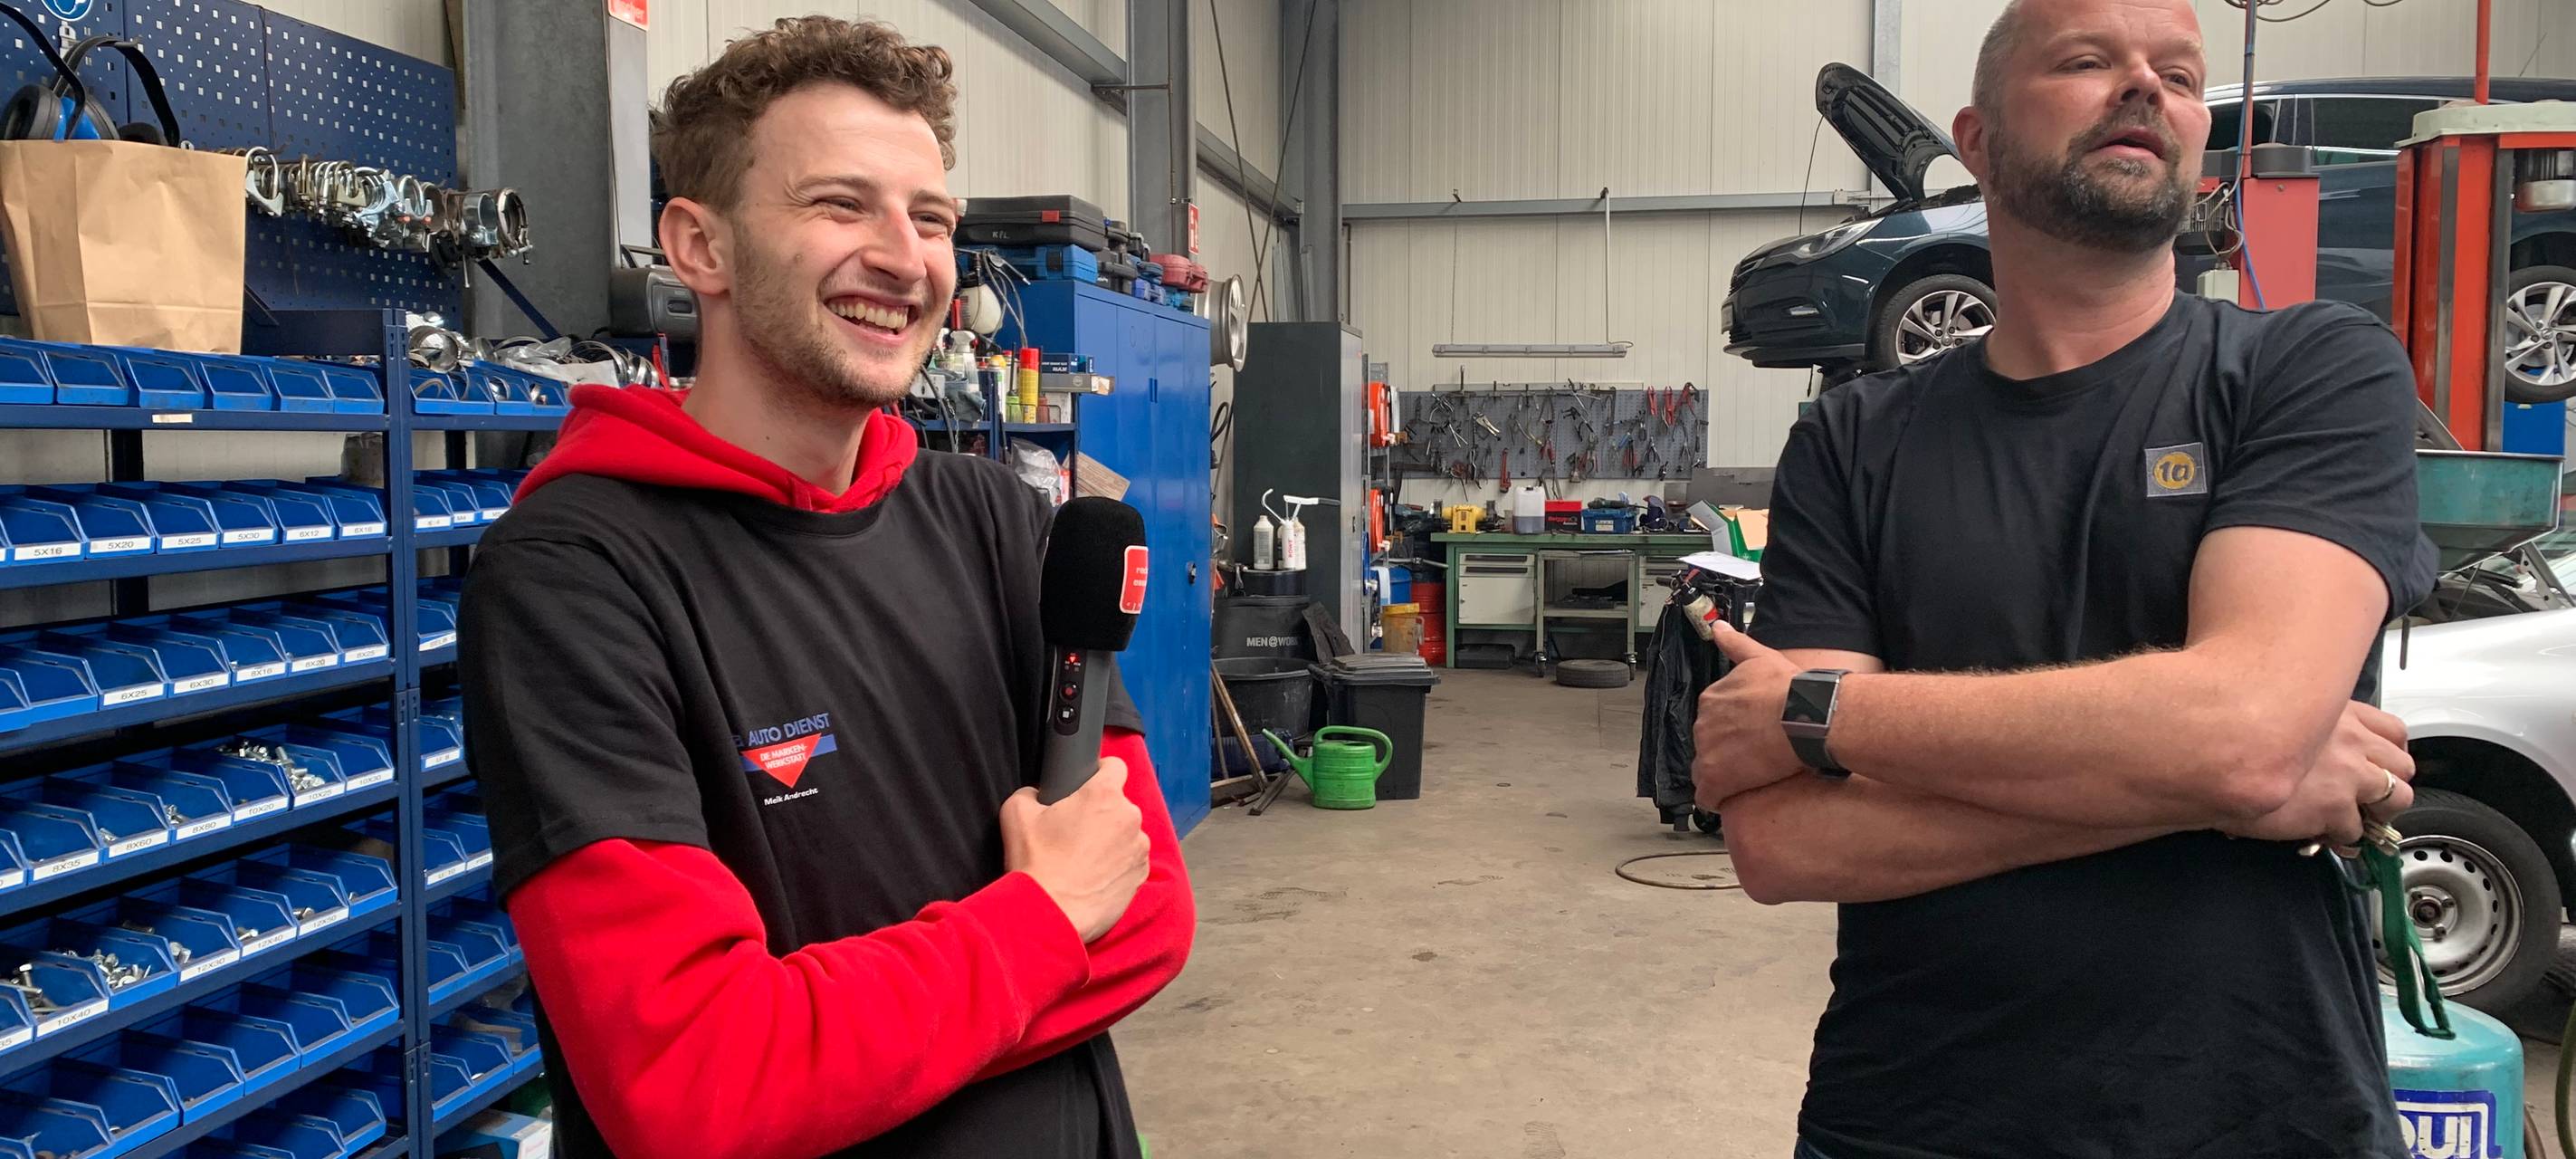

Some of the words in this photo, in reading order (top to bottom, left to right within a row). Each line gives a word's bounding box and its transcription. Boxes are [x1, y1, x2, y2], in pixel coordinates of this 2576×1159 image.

[237, 532, 260, 541] 5X30
[299, 530, 320, 538] 6X12
[108, 541, 135, 550] 5X20
[177, 537, 201, 546] 5X25
[33, 547, 62, 556] 5X16
[1245, 636, 1302, 647] MEN@WOR
[189, 679, 214, 688] 6X30
[121, 689, 148, 700] 6X25
[749, 727, 782, 746] AUTO
[783, 713, 831, 739] DIENST
[772, 743, 808, 760] MARKEN-
[764, 752, 806, 770] WERKSTATT
[309, 790, 332, 800] 10X25
[784, 788, 819, 801] Andrecht
[248, 803, 274, 815] 10X20
[52, 859, 81, 873] 8X35
[258, 934, 283, 948] 12X40
[197, 957, 225, 972] 12X30
[57, 1008, 91, 1026] 10X40
